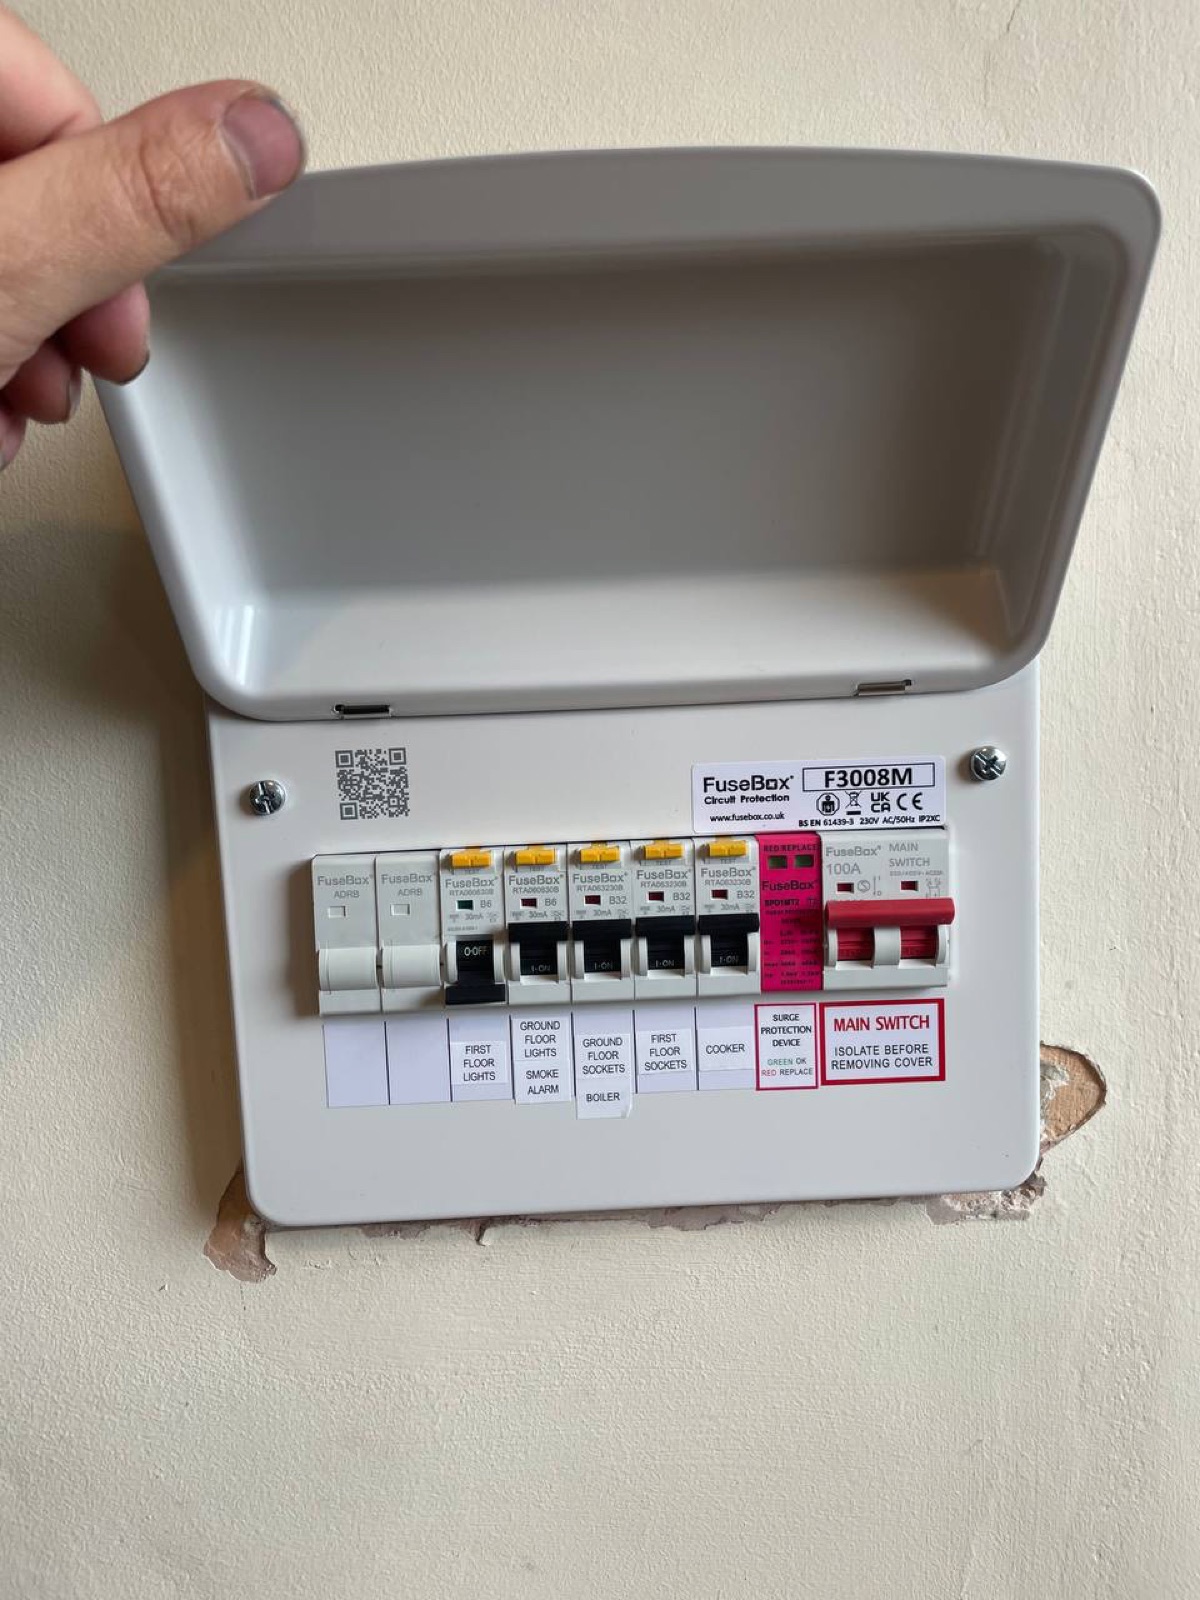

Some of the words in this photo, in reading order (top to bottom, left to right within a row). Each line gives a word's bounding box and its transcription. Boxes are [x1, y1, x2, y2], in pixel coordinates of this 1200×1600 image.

[824, 768, 913, 788] F3008M
[703, 775, 792, 793] FuseBox
[704, 796, 736, 805] Circuit
[740, 794, 790, 804] Protection
[709, 812, 785, 823] www.fusebox.co.uk
[798, 819, 808, 827] BS
[810, 819, 821, 827] EN
[823, 817, 854, 826] 61439-3
[859, 816, 880, 825] 230V
[882, 815, 916, 824] AC/50Hz
[918, 814, 941, 823] IP2XC
[825, 846, 878, 857] FuseBox
[889, 842, 919, 852] MAIN
[889, 858, 930, 868] SWITCH
[700, 867, 752, 878] FuseBox
[826, 862, 861, 875] 100A
[381, 873, 433, 884] FuseBox
[572, 873, 625, 884] FuseBox
[636, 869, 688, 880] FuseBox
[317, 875, 370, 886] FuseBox
[445, 878, 495, 889] FuseBox
[508, 874, 560, 886] FuseBox
[761, 880, 815, 891] FuseBox
[333, 890, 360, 898] ADRB
[398, 888, 423, 896] ADRB
[673, 892, 691, 901] B32
[736, 890, 755, 899] B32
[480, 900, 492, 908] B6
[544, 898, 557, 906] B6
[609, 896, 627, 905] B32
[520, 1020, 560, 1031] GROUND
[833, 1016, 870, 1031] MAIN
[875, 1014, 930, 1031] SWITCH
[760, 1025, 812, 1034] PROTECTION
[525, 1034, 556, 1044] FLOOR
[582, 1037, 623, 1047] GROUND
[651, 1033, 677, 1043] FIRST
[772, 1039, 801, 1047] DEVICE
[465, 1045, 491, 1054] FIRST
[525, 1048, 557, 1058] LIGHTS
[650, 1047, 681, 1057] FLOOR
[705, 1043, 746, 1054] COOKER
[834, 1045, 880, 1056] ISOLATE
[884, 1043, 929, 1055] BEFORE
[588, 1051, 619, 1060] FLOOR
[463, 1058, 495, 1068] FLOOR
[644, 1060, 687, 1071] SOCKETS
[767, 1058, 793, 1066] GREEN
[795, 1057, 807, 1065] OK
[831, 1058, 890, 1070] REMOVING
[894, 1056, 934, 1068] COVER
[526, 1069, 559, 1079] SMOKE
[582, 1064, 626, 1075] SOCKETS
[779, 1068, 813, 1076] REPLACE
[463, 1071, 496, 1082] LIGHTS
[527, 1085, 559, 1095] ALARM
[586, 1092, 620, 1102] BOILER
